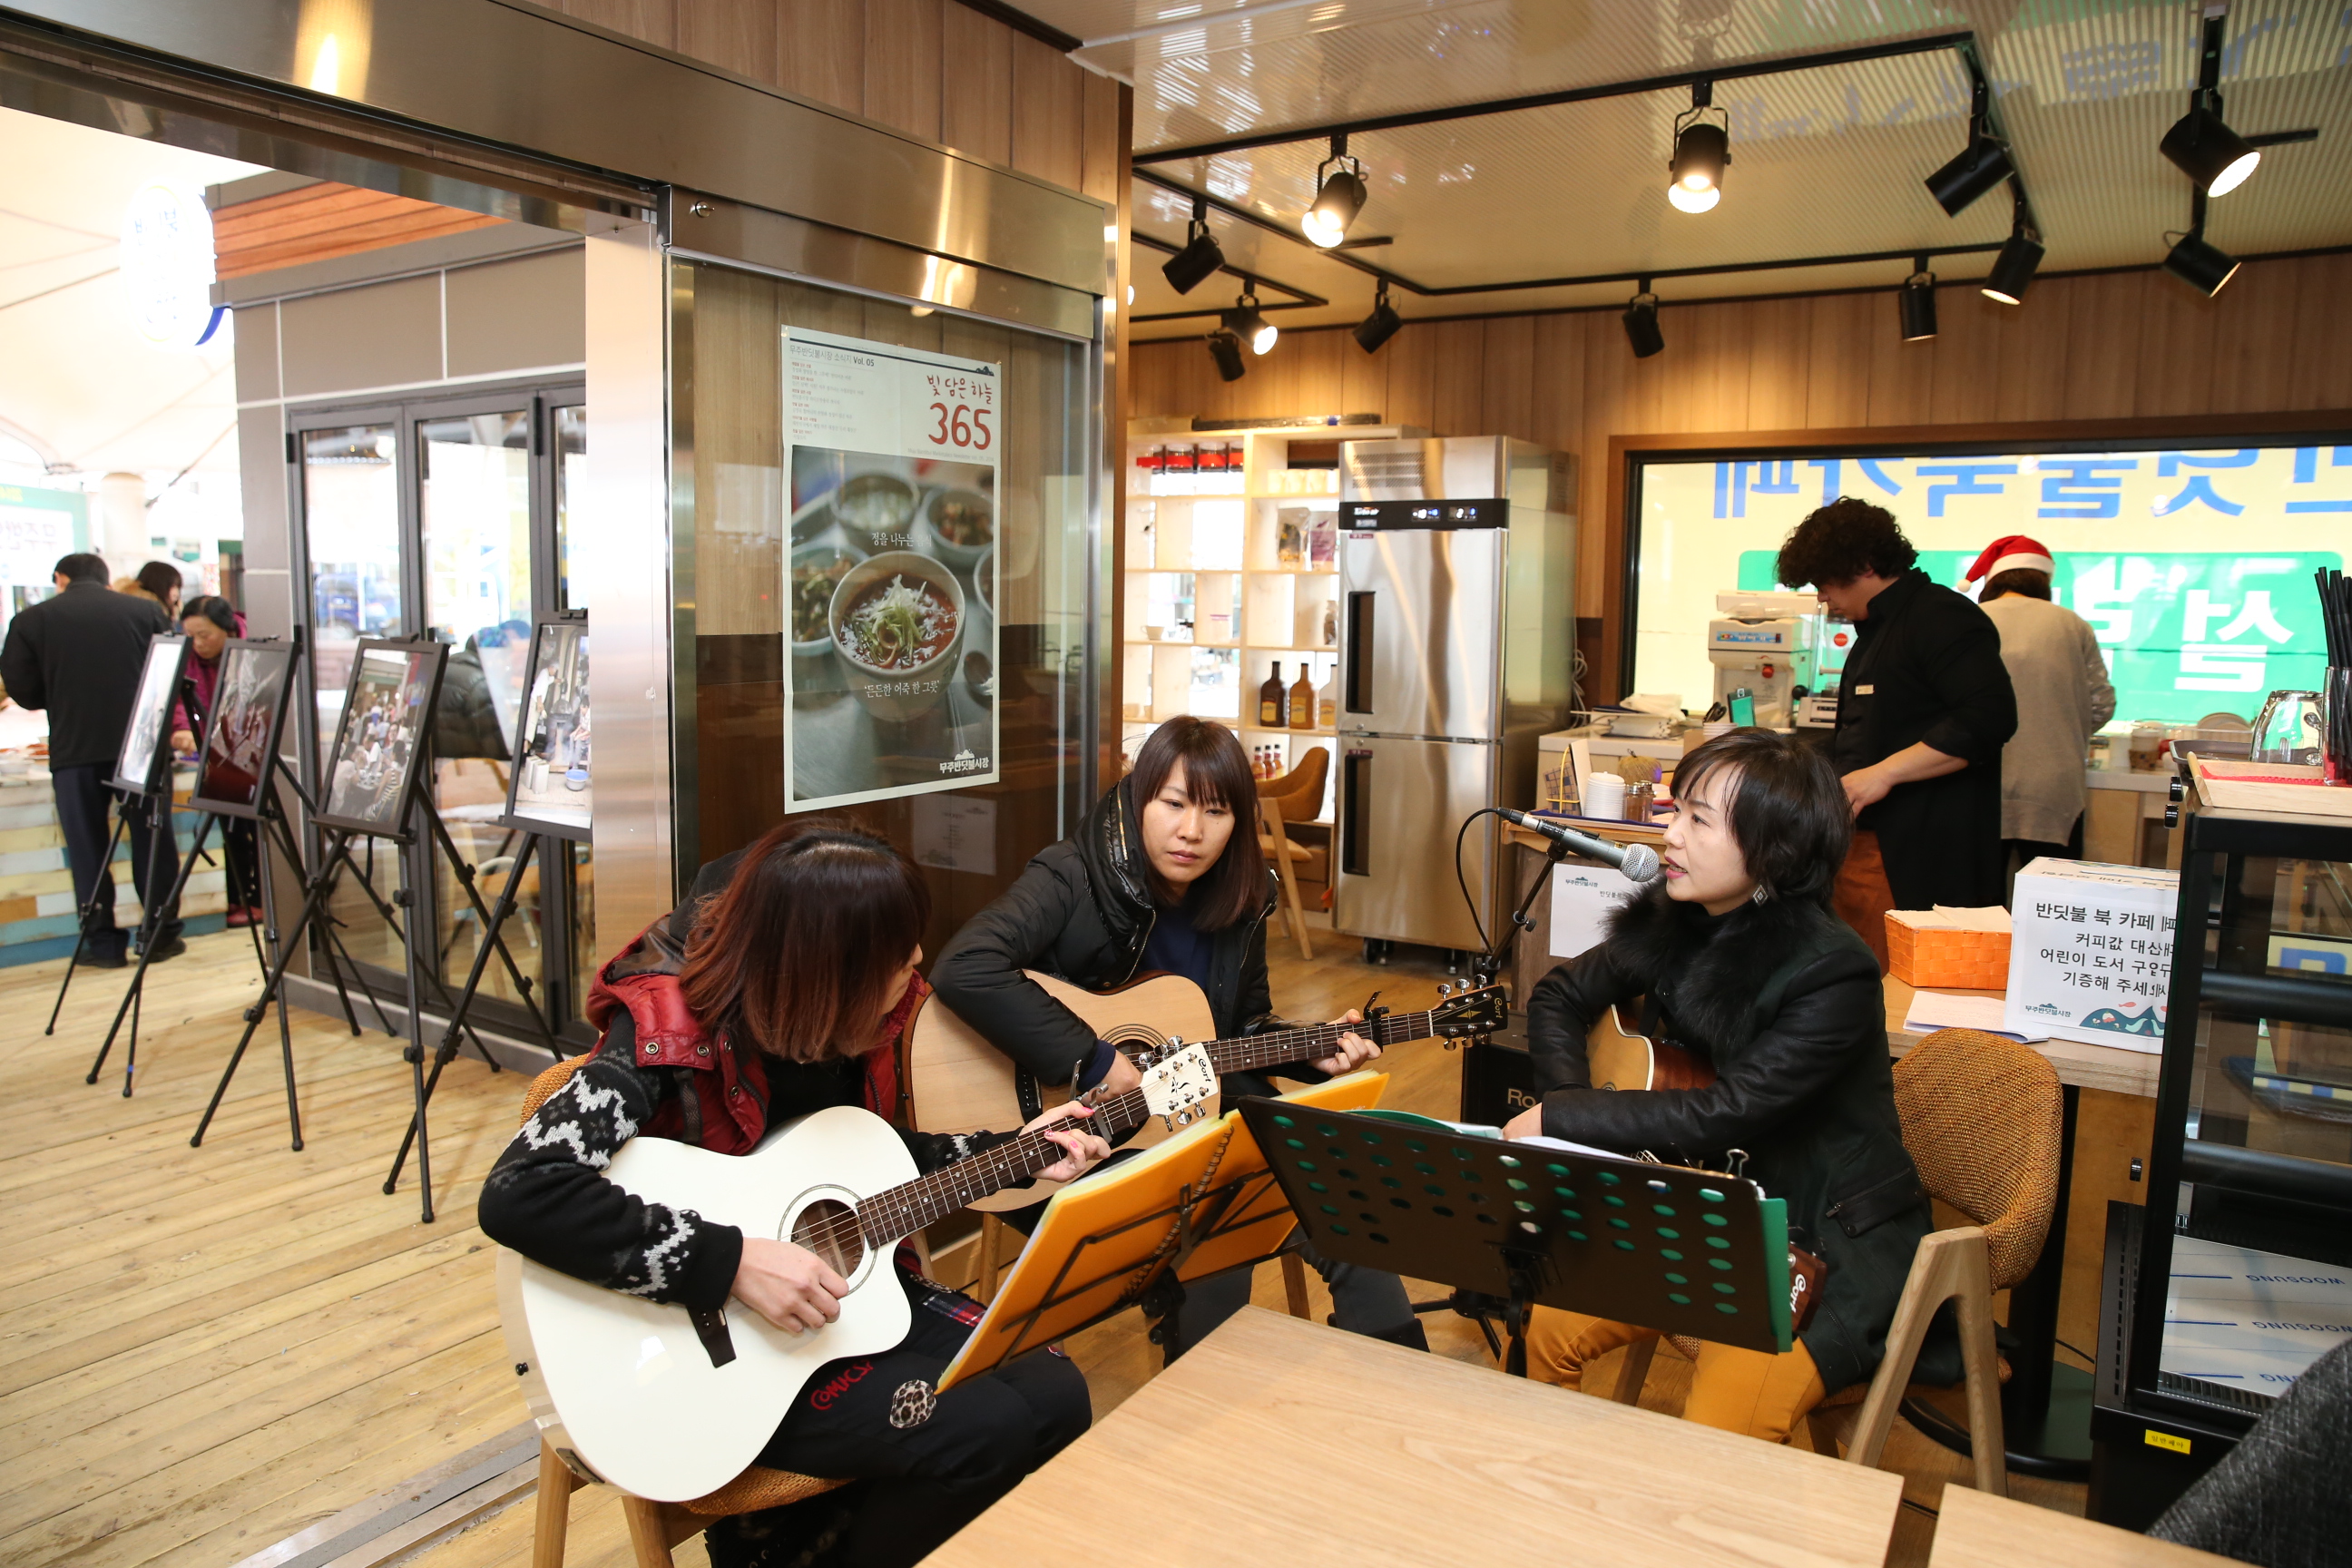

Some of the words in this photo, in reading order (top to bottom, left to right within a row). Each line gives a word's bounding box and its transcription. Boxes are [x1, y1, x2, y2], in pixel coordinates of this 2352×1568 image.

[790, 345, 832, 360] 무주반딧불시장
[835, 352, 852, 364] 소식지
[854, 357, 865, 366] Vol.
[867, 358, 875, 367] 05
[927, 375, 940, 397] 빛
[945, 377, 966, 399] 담은
[971, 381, 993, 405] 하늘
[928, 402, 992, 450] 365
[872, 532, 888, 546] 정을
[890, 533, 914, 547] 나누는
[895, 681, 910, 695] 어죽
[913, 681, 921, 695] 한
[939, 757, 989, 773] 무주반딧불시장
[2035, 902, 2087, 923] 반딧불
[2093, 908, 2112, 926] 북
[2119, 912, 2155, 931] 카페
[2075, 933, 2123, 951] 커피값
[2040, 947, 2085, 966] 어린이
[2092, 956, 2124, 972] 도서
[2062, 972, 2109, 990] 기증해
[1494, 997, 1504, 1019] Cort
[2025, 1004, 2072, 1018] 무주반딧불시장
[1198, 1058, 1212, 1083] Cort
[2245, 1274, 2346, 1285] WOOSUNG
[1789, 1273, 1807, 1313] Cort
